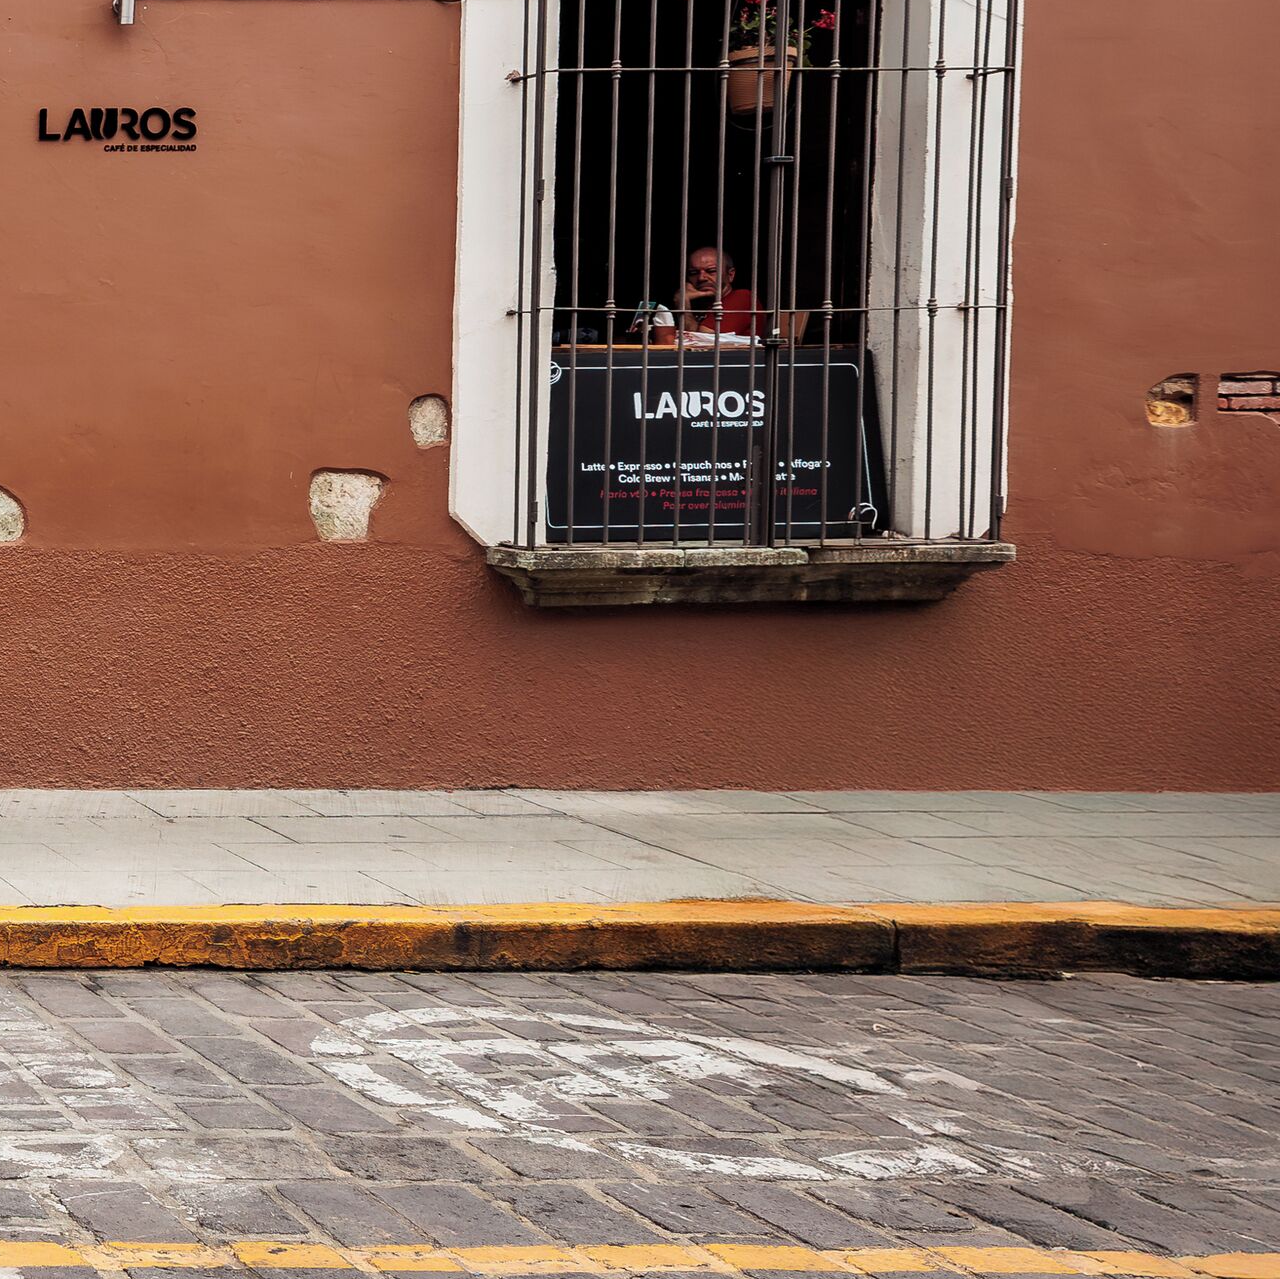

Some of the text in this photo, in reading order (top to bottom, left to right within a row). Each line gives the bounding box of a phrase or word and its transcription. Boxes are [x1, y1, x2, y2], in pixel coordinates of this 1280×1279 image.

[38, 107, 198, 141] LAUROS
[103, 143, 197, 152] CAFÉ DE ESPECIALIDAD
[617, 461, 662, 473] Exprsso
[645, 473, 672, 483] Brew
